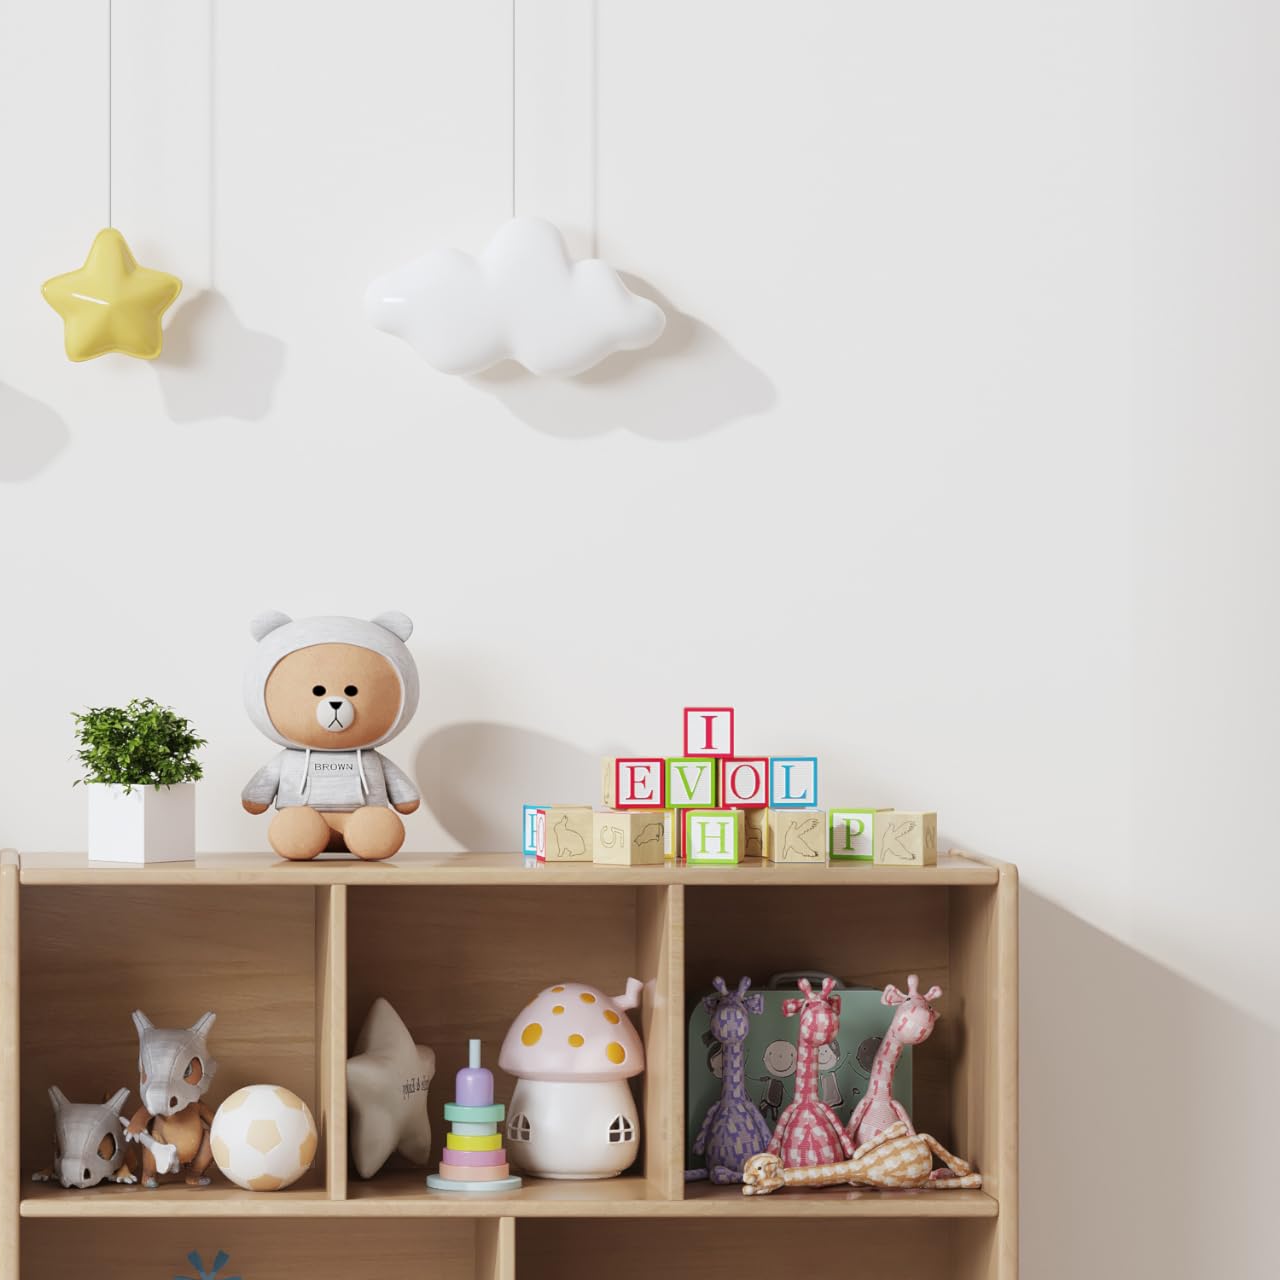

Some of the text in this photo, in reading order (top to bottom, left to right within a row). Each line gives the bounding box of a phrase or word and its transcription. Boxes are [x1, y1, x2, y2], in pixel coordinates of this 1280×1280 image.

[699, 715, 718, 750] I
[314, 763, 353, 771] BROWN
[696, 821, 728, 854] H
[842, 818, 865, 851] P
